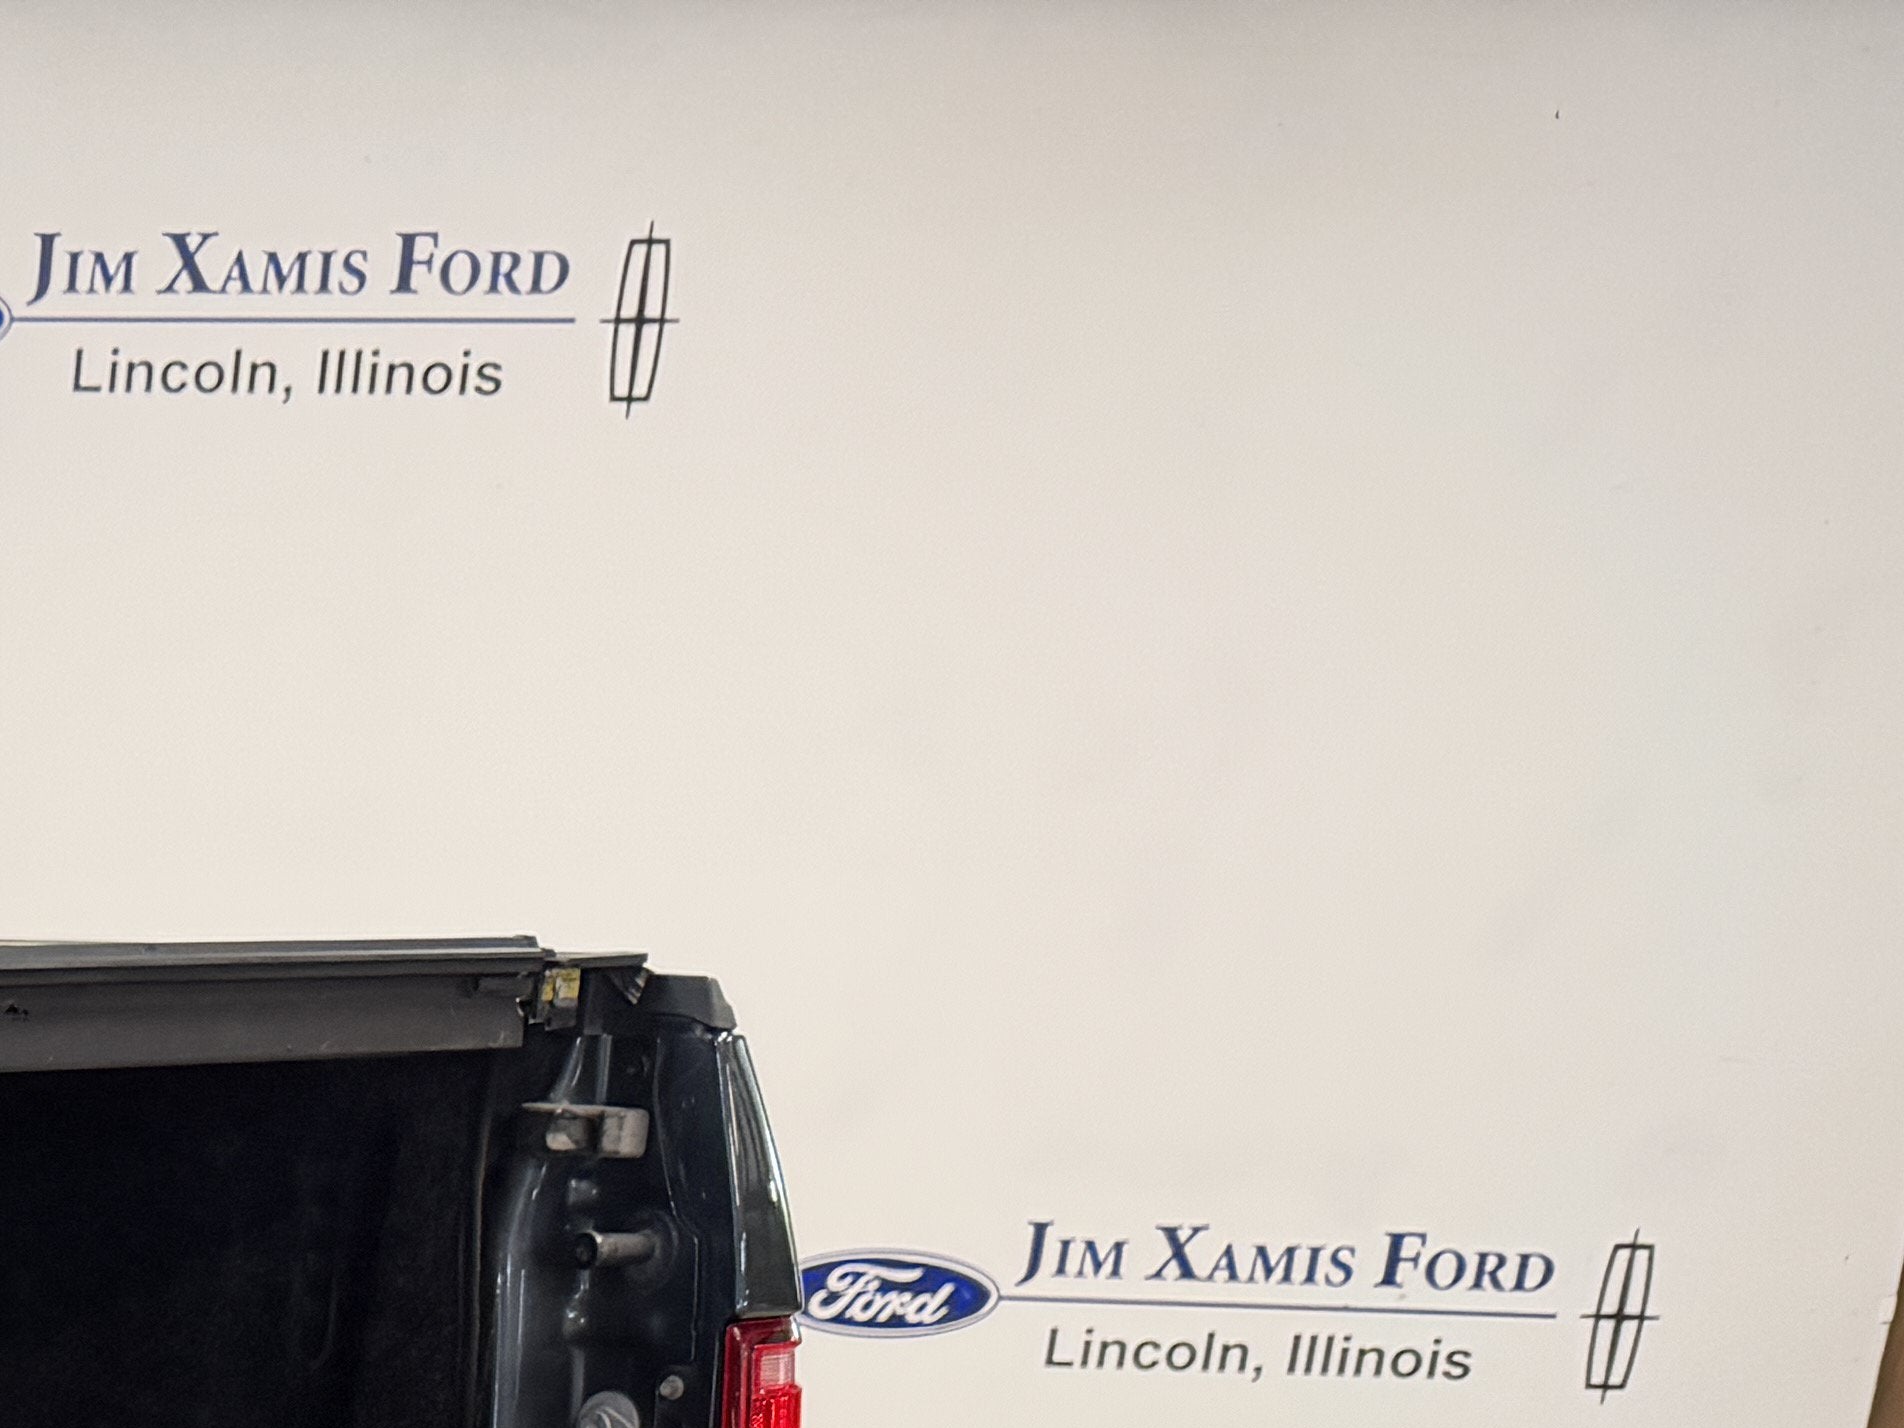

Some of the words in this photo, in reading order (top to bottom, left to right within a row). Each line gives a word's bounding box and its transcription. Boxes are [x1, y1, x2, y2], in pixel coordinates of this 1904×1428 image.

[25, 231, 138, 307] JIM
[155, 231, 368, 296] XAMIS
[389, 231, 570, 296] FORD
[72, 346, 293, 405] Lincoln,
[317, 348, 503, 397] Illinois
[1013, 1220, 1128, 1288] JIM
[1144, 1223, 1356, 1288] XAMIS
[1373, 1231, 1556, 1293] FORD
[807, 1262, 956, 1325] Ford
[1044, 1327, 1263, 1383] Lincoln,
[1286, 1333, 1473, 1381] Illinois
